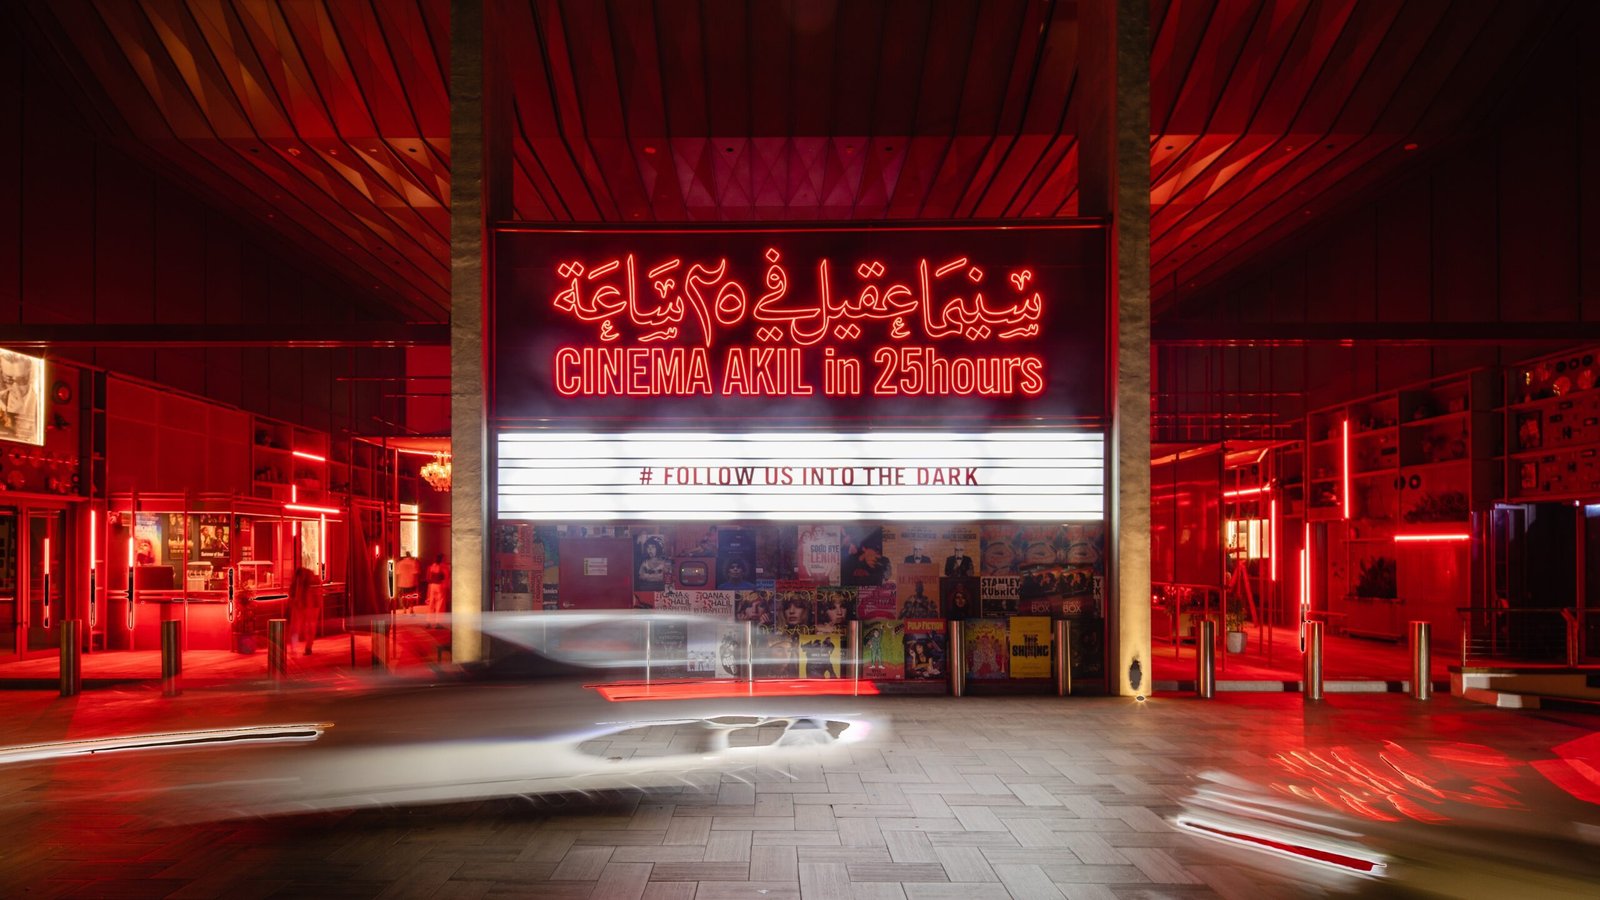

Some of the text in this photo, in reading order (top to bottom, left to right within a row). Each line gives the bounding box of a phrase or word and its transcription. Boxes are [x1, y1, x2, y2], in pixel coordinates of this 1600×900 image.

[555, 347, 1043, 395] CINEMA AKIL in 25hours
[639, 467, 979, 486] # FOLLOW US INTO THE DARK
[981, 578, 1020, 587] STANLEY
[906, 621, 921, 631] PULP
[922, 621, 944, 631] FICTION
[1023, 634, 1039, 643] THE
[1012, 645, 1049, 658] SHINING
